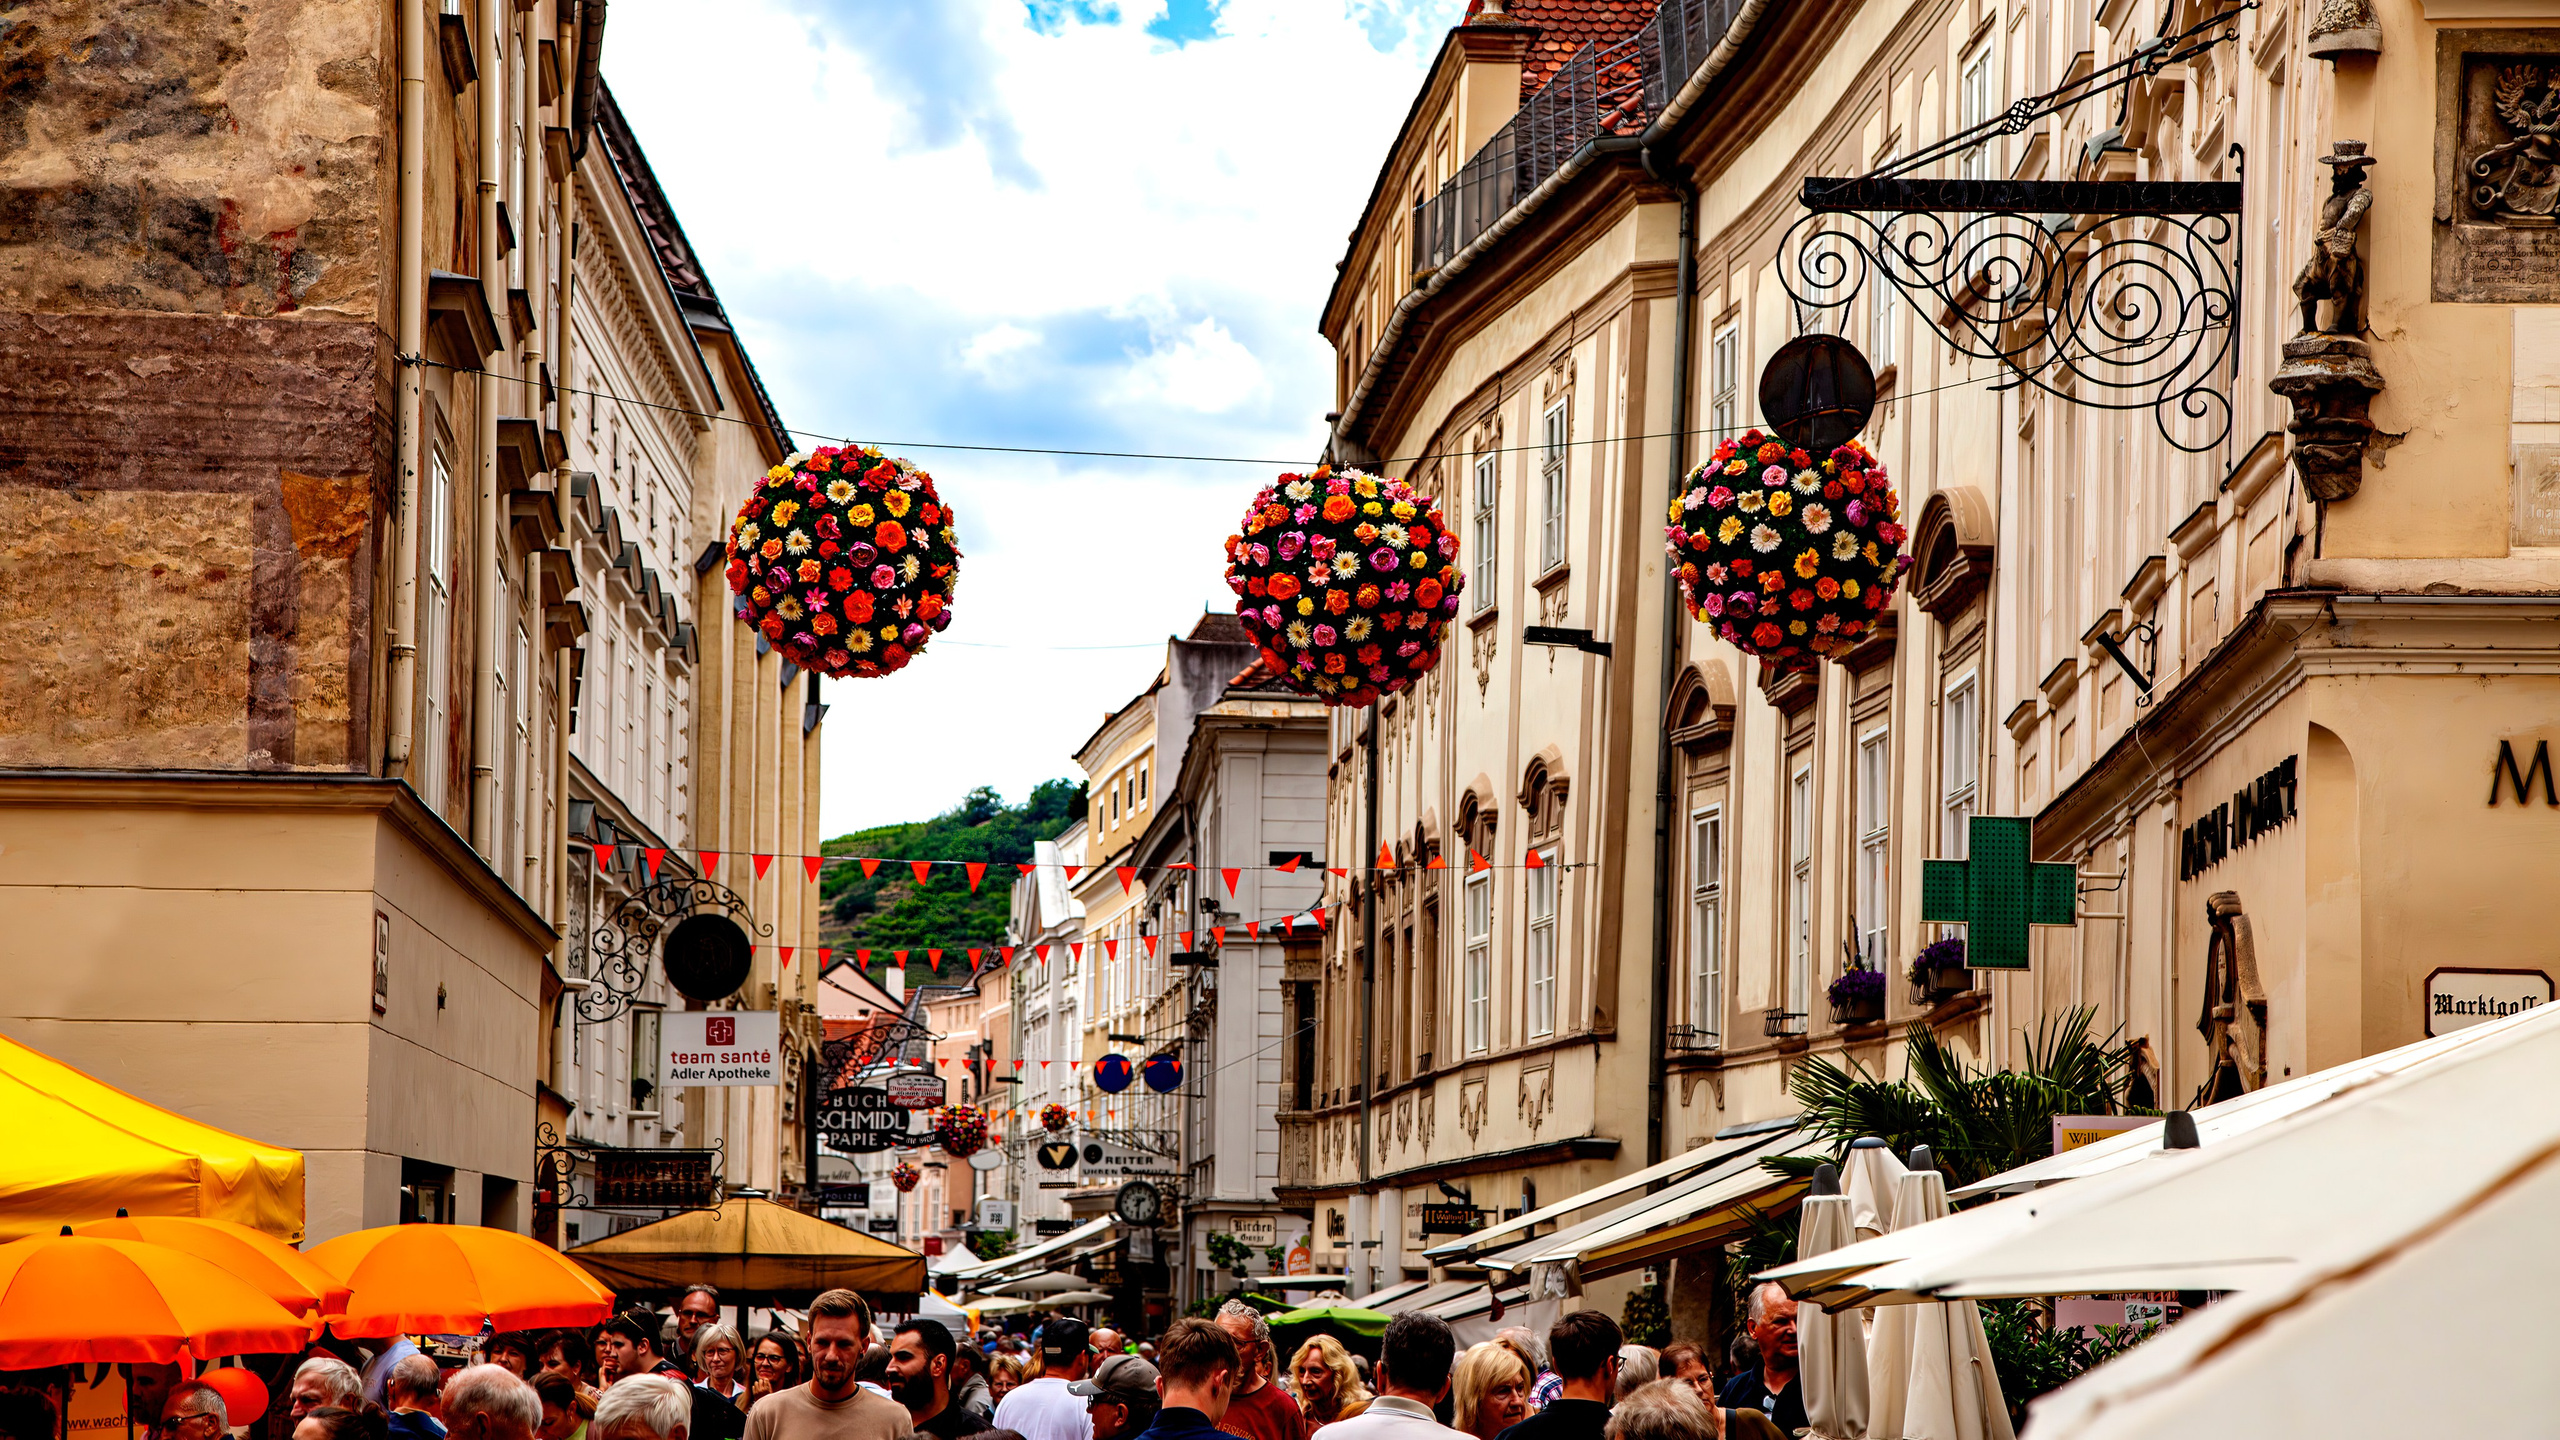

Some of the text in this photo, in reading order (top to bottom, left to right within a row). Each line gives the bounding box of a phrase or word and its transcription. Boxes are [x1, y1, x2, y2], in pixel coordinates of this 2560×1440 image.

[2433, 993, 2544, 1020] Marktgass
[671, 1048, 771, 1065] team santé
[670, 1066, 771, 1082] Adler Apotheke
[833, 1094, 887, 1108] BUCH
[816, 1110, 906, 1130] SCHMIDL
[830, 1132, 889, 1146] PAPIE
[2068, 1132, 2110, 1145] Willk
[1105, 1156, 1154, 1165] REITER
